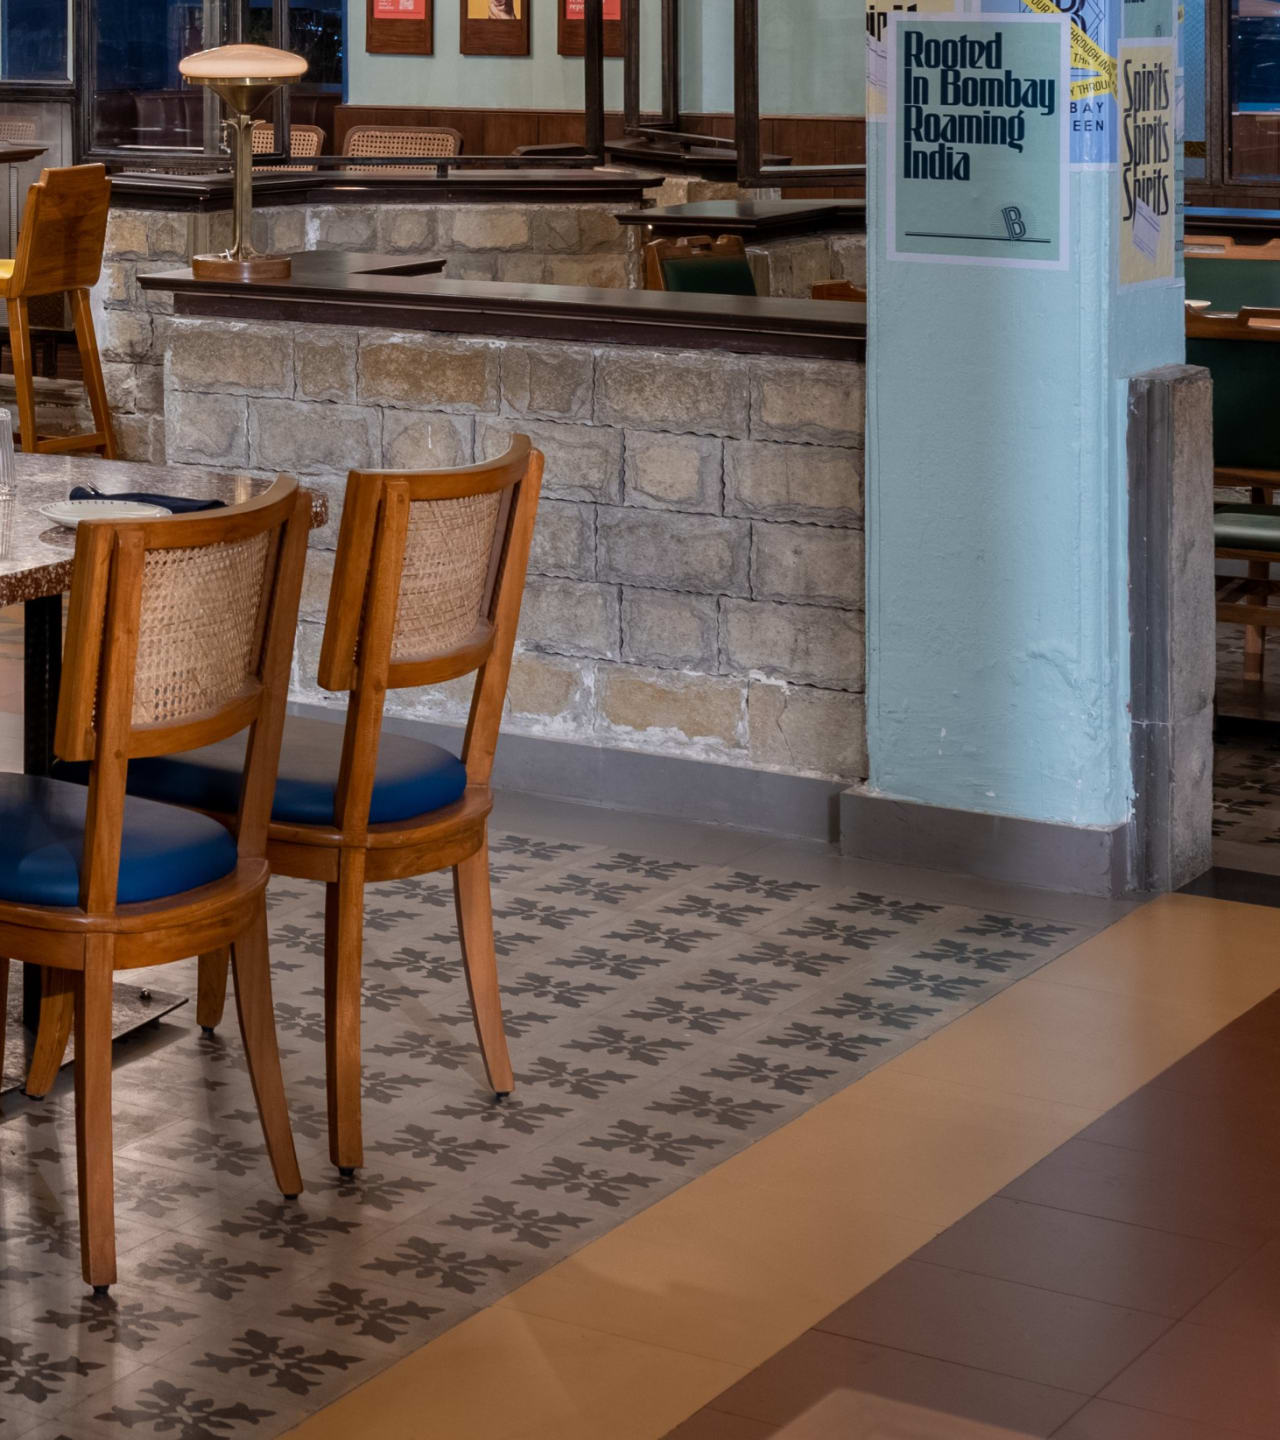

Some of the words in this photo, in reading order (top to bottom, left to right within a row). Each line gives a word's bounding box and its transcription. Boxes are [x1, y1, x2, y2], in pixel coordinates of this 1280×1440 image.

[904, 31, 1002, 70] Rooted
[904, 68, 929, 105] In
[940, 69, 1056, 116] Bombay
[1123, 60, 1170, 123] Spirits
[904, 105, 1025, 153] Roaming
[1123, 113, 1170, 176] Spirits
[904, 142, 970, 180] India
